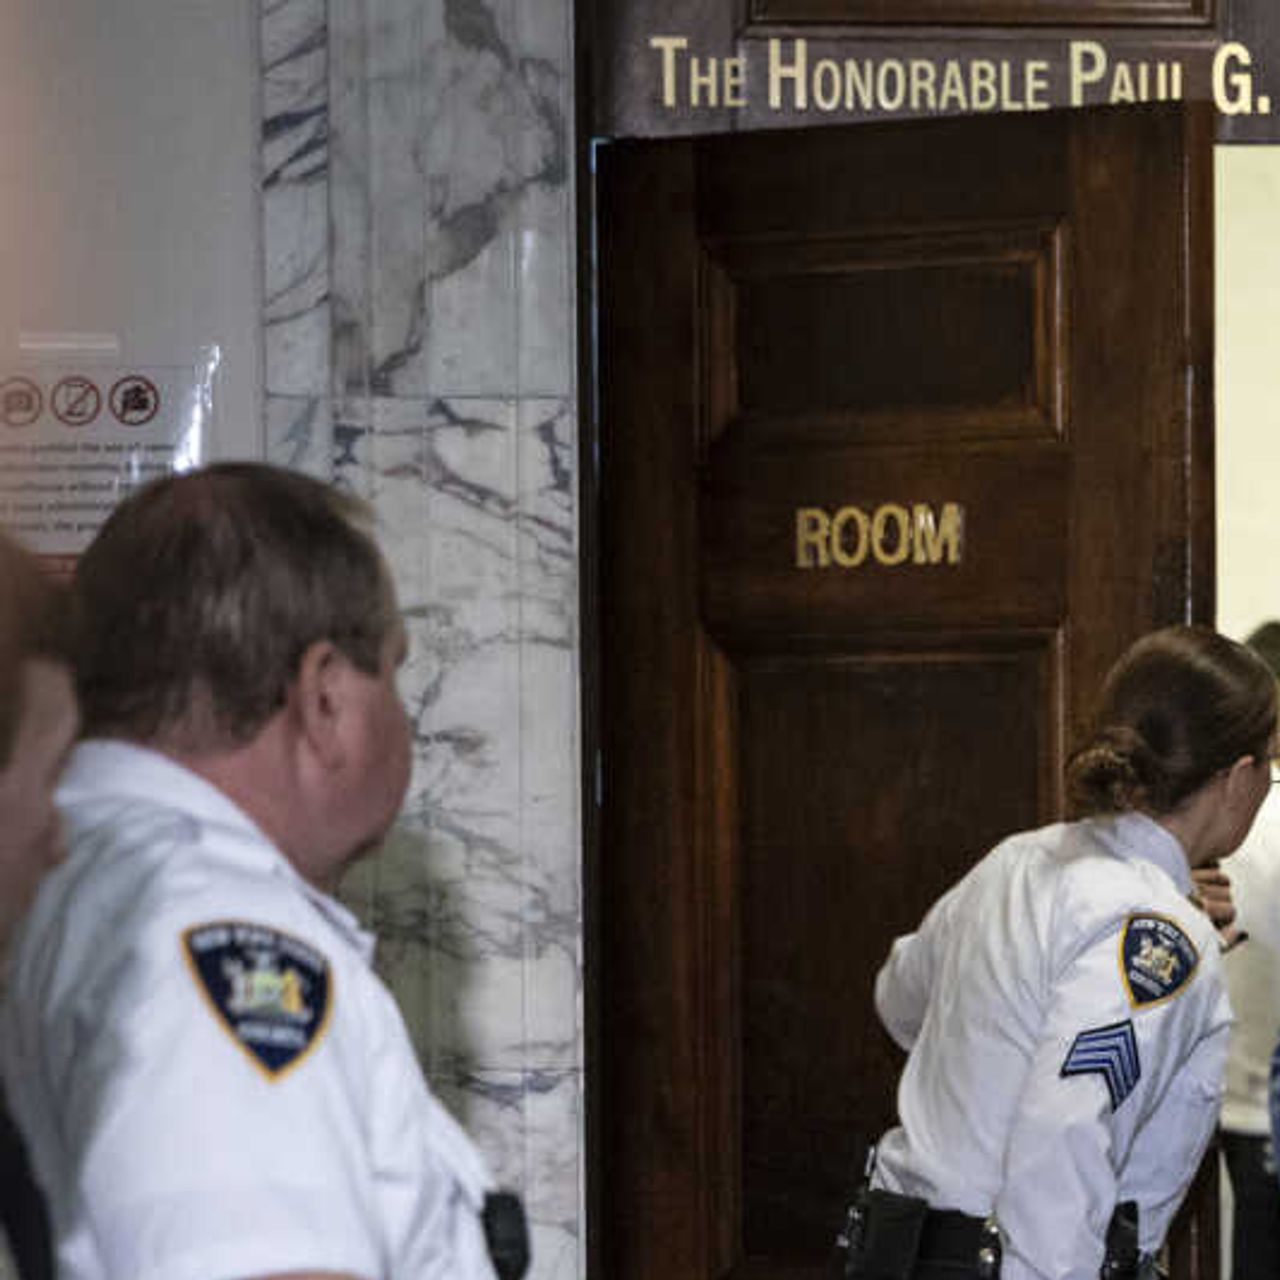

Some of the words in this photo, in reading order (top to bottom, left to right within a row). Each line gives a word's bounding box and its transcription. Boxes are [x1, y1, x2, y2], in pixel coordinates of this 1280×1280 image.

[649, 36, 746, 108] THE
[767, 37, 1050, 112] HONORABLE
[1212, 41, 1270, 116] G.
[797, 502, 962, 568] ROOM
